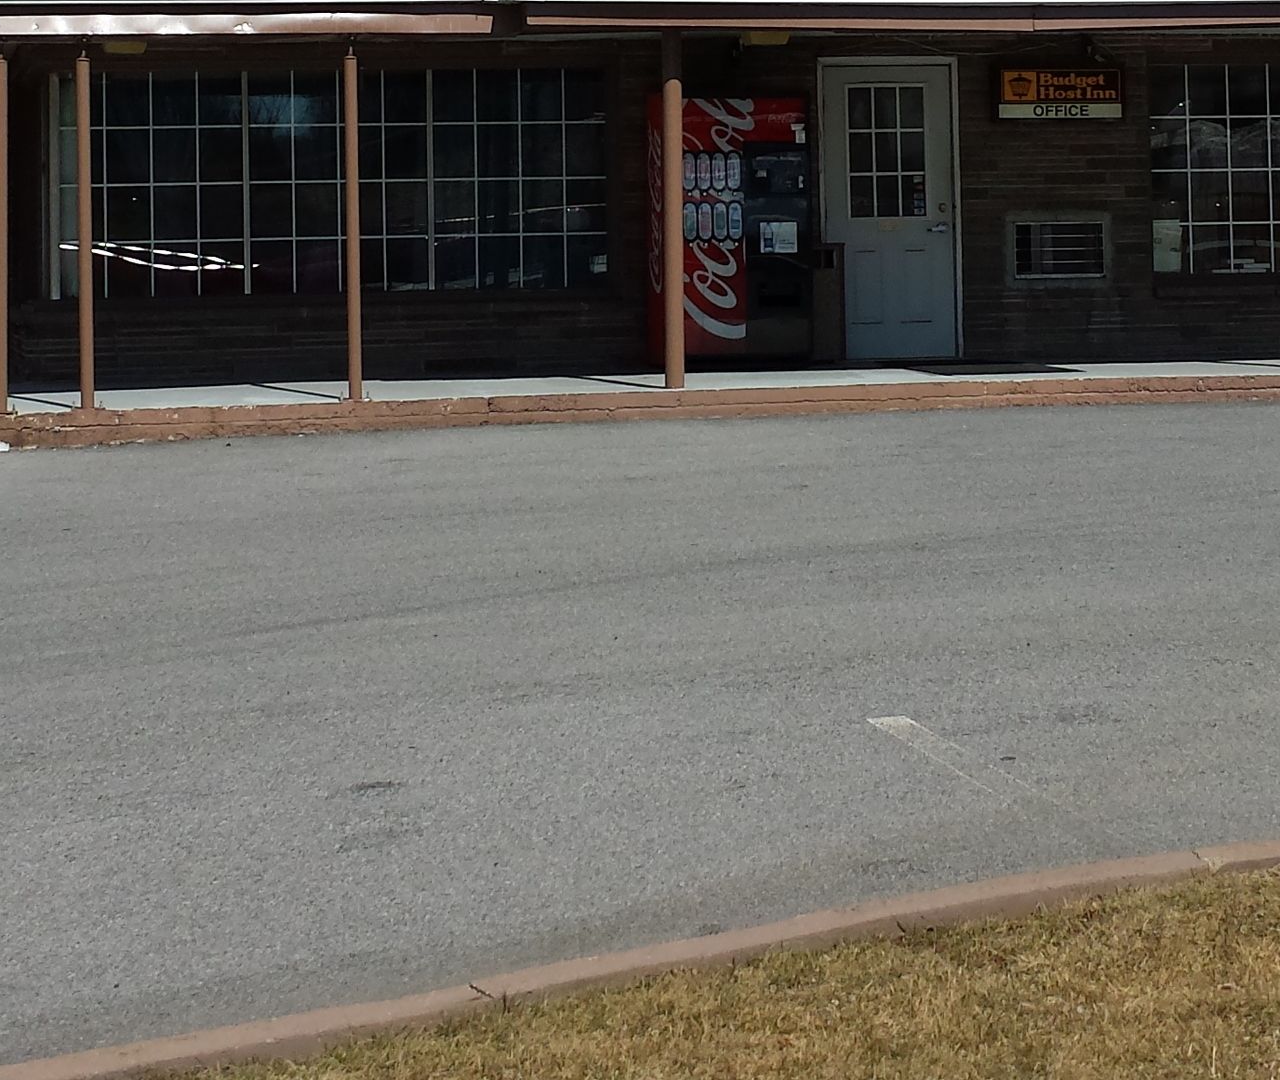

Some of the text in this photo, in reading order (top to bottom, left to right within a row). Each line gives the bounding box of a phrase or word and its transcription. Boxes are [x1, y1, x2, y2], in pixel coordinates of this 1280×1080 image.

[1039, 73, 1105, 88] Budget
[1039, 86, 1084, 99] Host
[1086, 86, 1117, 99] Inn
[1033, 105, 1090, 117] OFFICE
